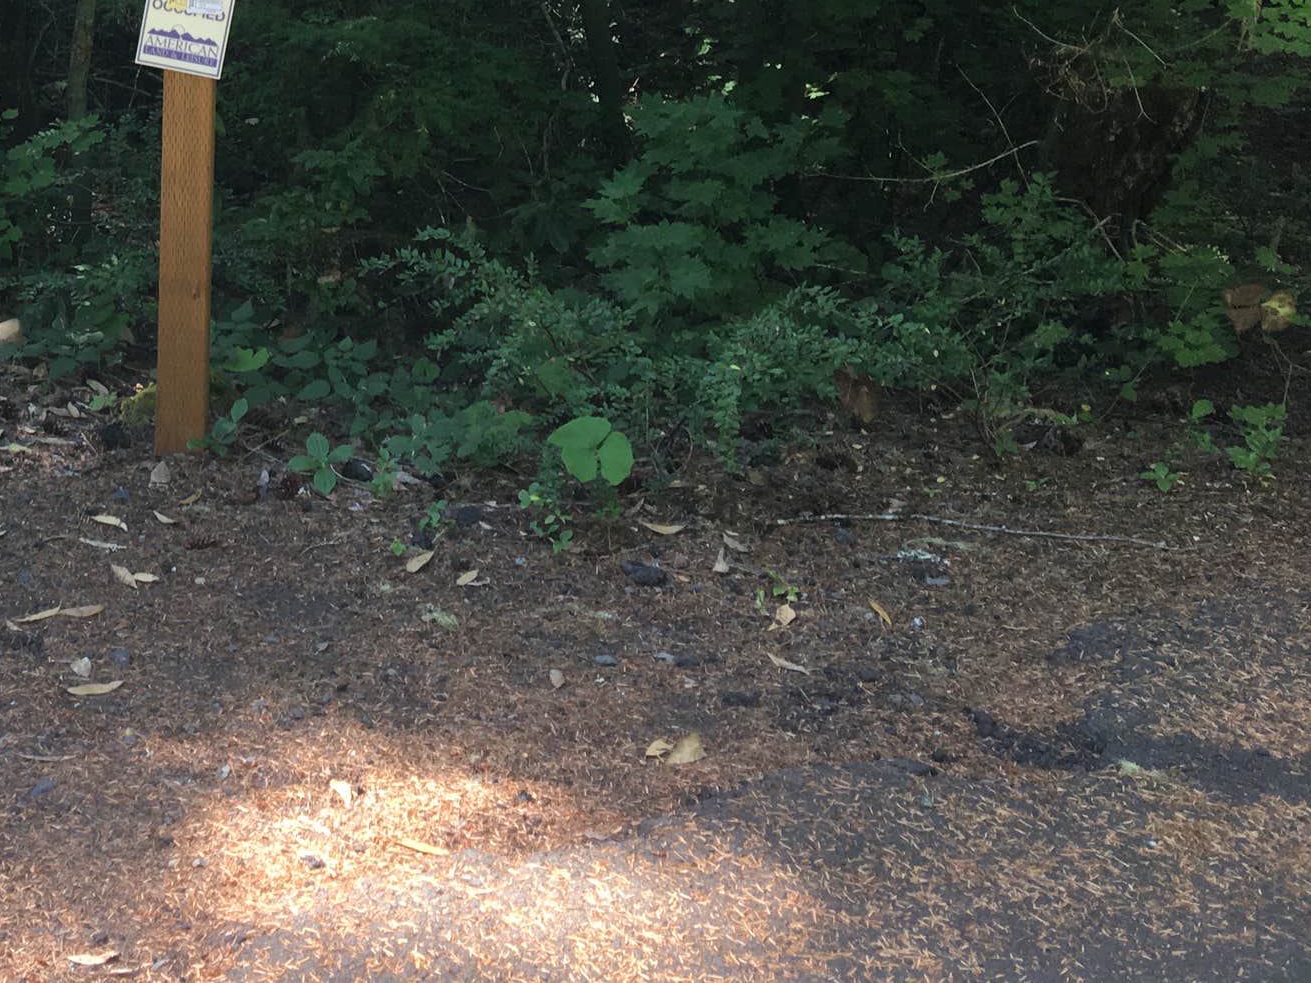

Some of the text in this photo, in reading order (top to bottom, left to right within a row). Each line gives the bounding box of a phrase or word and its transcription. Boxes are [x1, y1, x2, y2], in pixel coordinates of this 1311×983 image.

[145, 35, 219, 58] AMERICAN
[145, 46, 169, 57] LAND
[181, 52, 215, 66] LEISURE
